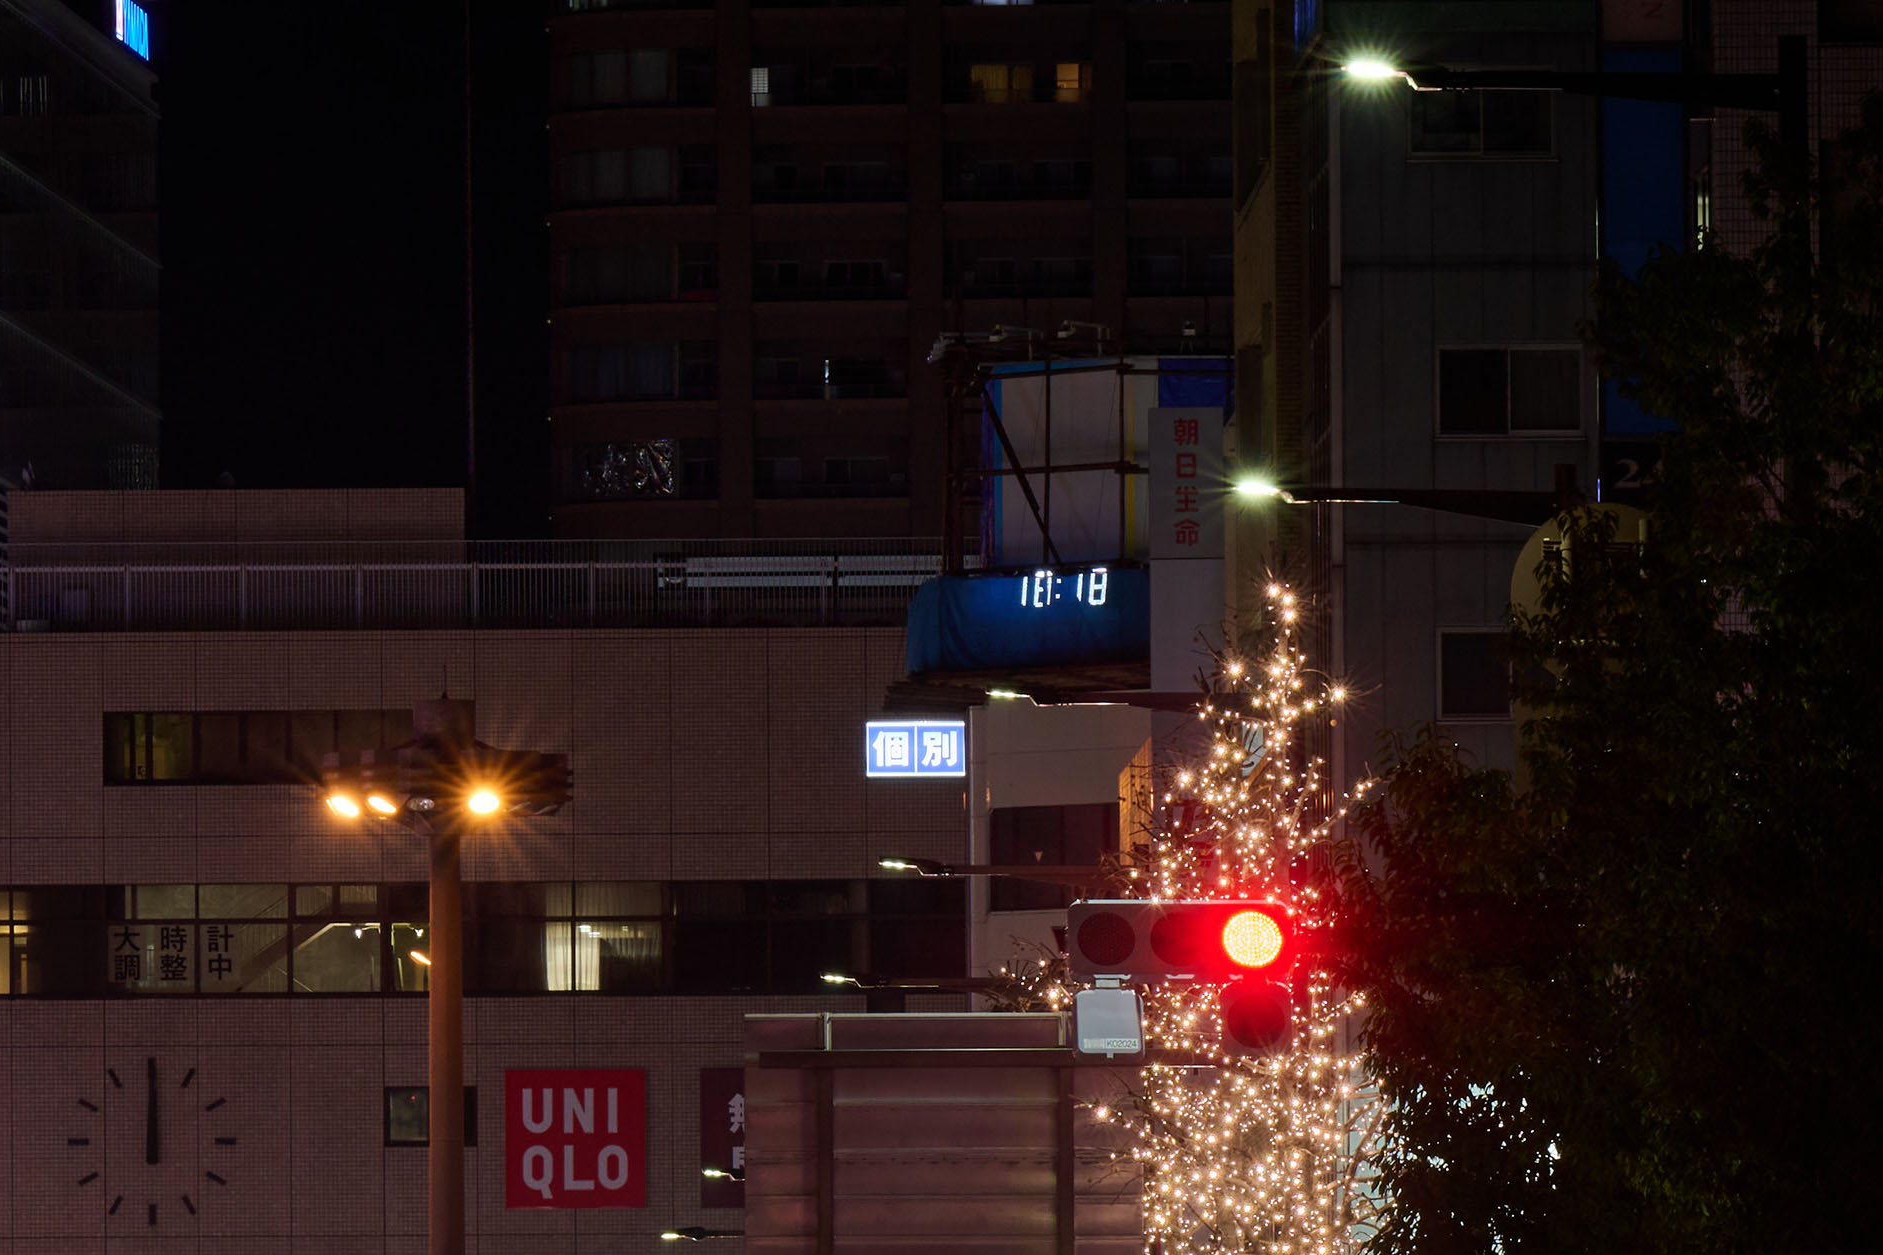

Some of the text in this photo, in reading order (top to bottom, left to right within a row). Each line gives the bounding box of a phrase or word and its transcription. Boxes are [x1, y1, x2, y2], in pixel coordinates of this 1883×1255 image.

[1174, 418, 1200, 546] 朝日生命
[872, 731, 958, 767] 個別
[114, 925, 234, 953] 大時計
[114, 954, 232, 981] 調整中
[522, 1088, 618, 1134] UNI
[522, 1145, 628, 1199] QLO
